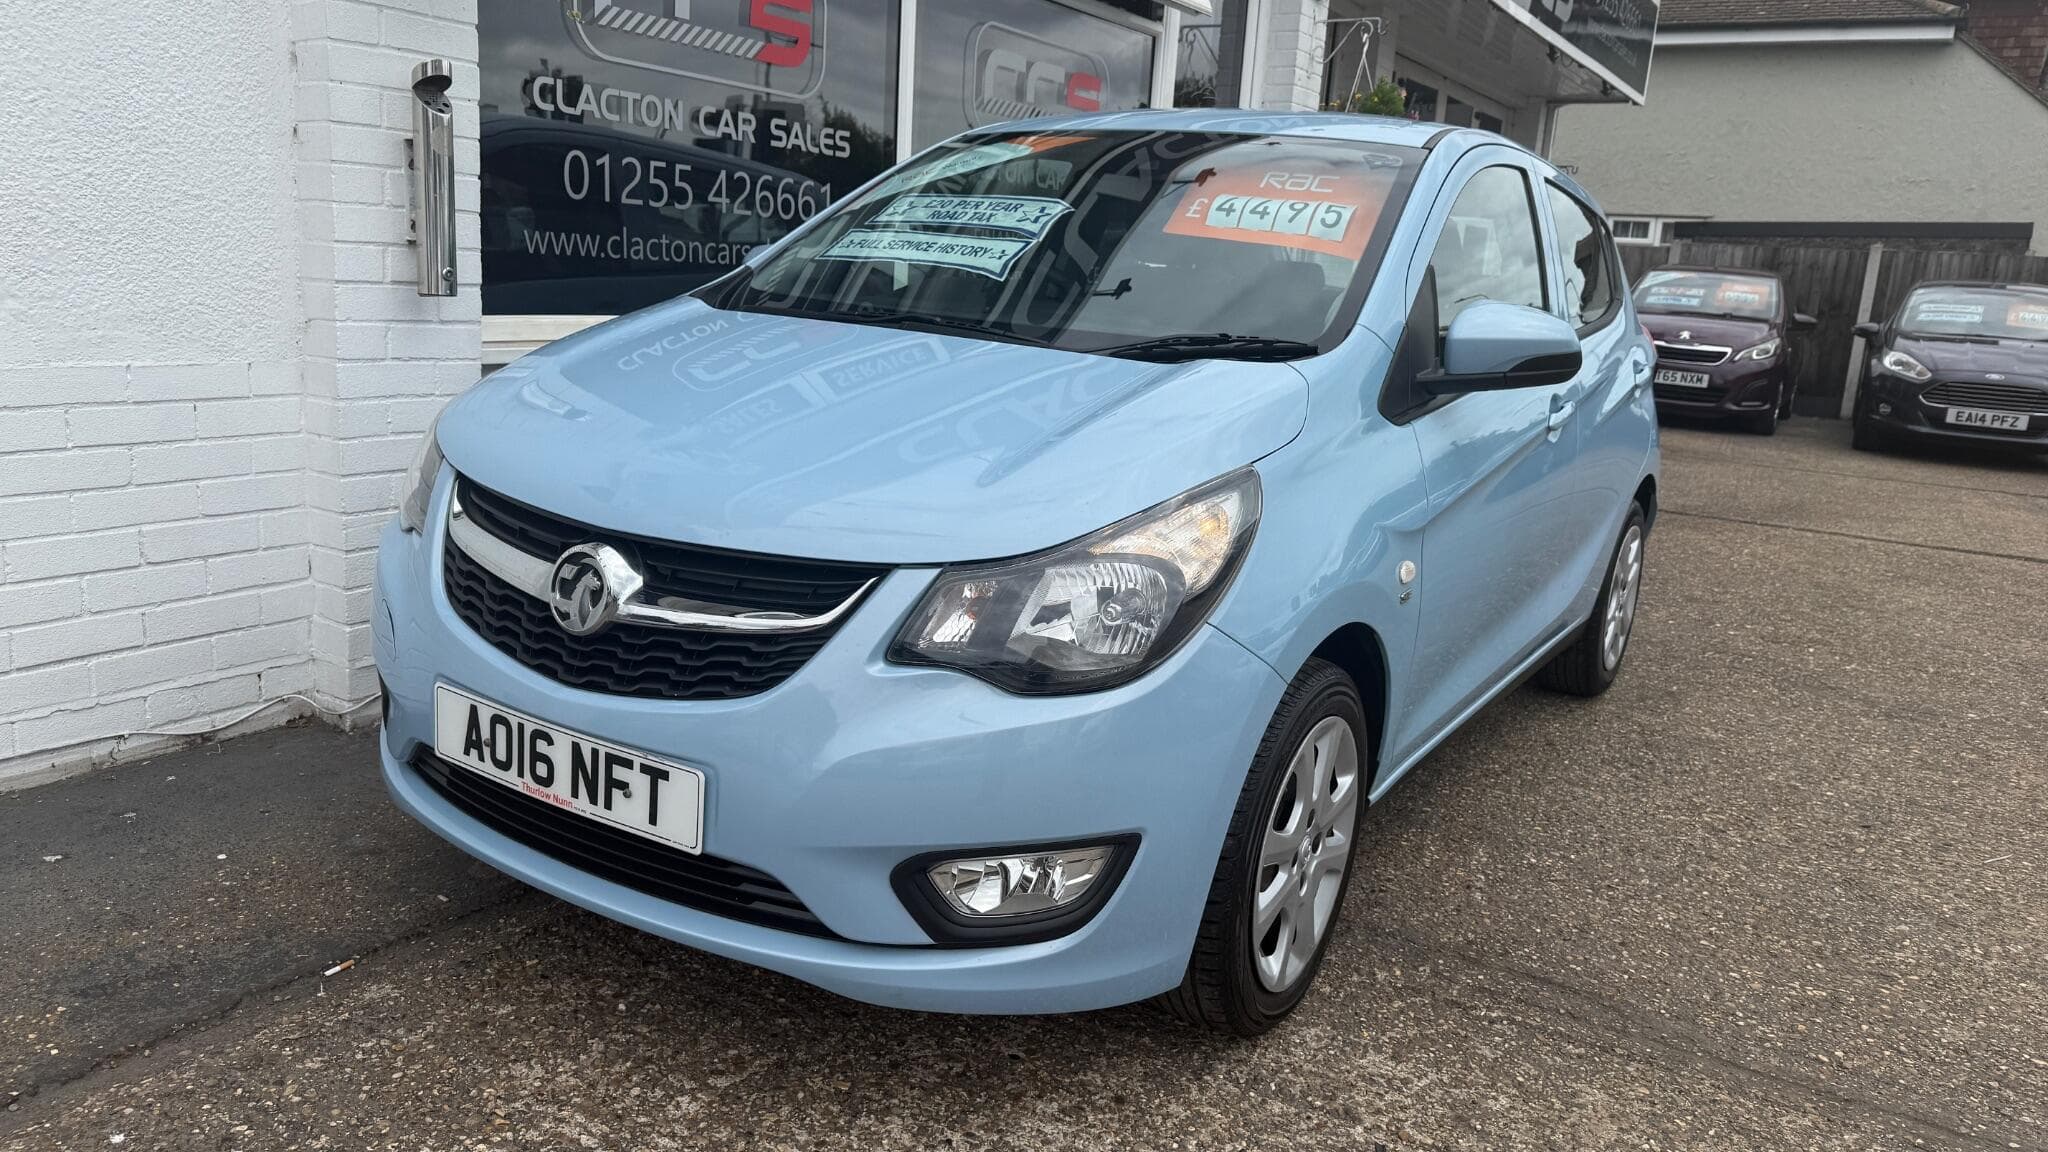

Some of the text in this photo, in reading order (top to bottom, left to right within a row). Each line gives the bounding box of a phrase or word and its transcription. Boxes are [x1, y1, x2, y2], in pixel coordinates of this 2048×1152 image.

[532, 75, 851, 158] CLACTON CAR SALES
[563, 149, 694, 211] 01255
[707, 169, 833, 223] 426661
[926, 210, 997, 224] ROAD TAX
[952, 199, 982, 211] PER
[982, 201, 1025, 213] YEAR
[854, 238, 993, 259] FULL SERVICE HISTORY
[1955, 411, 2020, 428] EA14 PFZ
[463, 703, 670, 827] AO16 NFT
[521, 781, 573, 809] Thurlow Nunn
